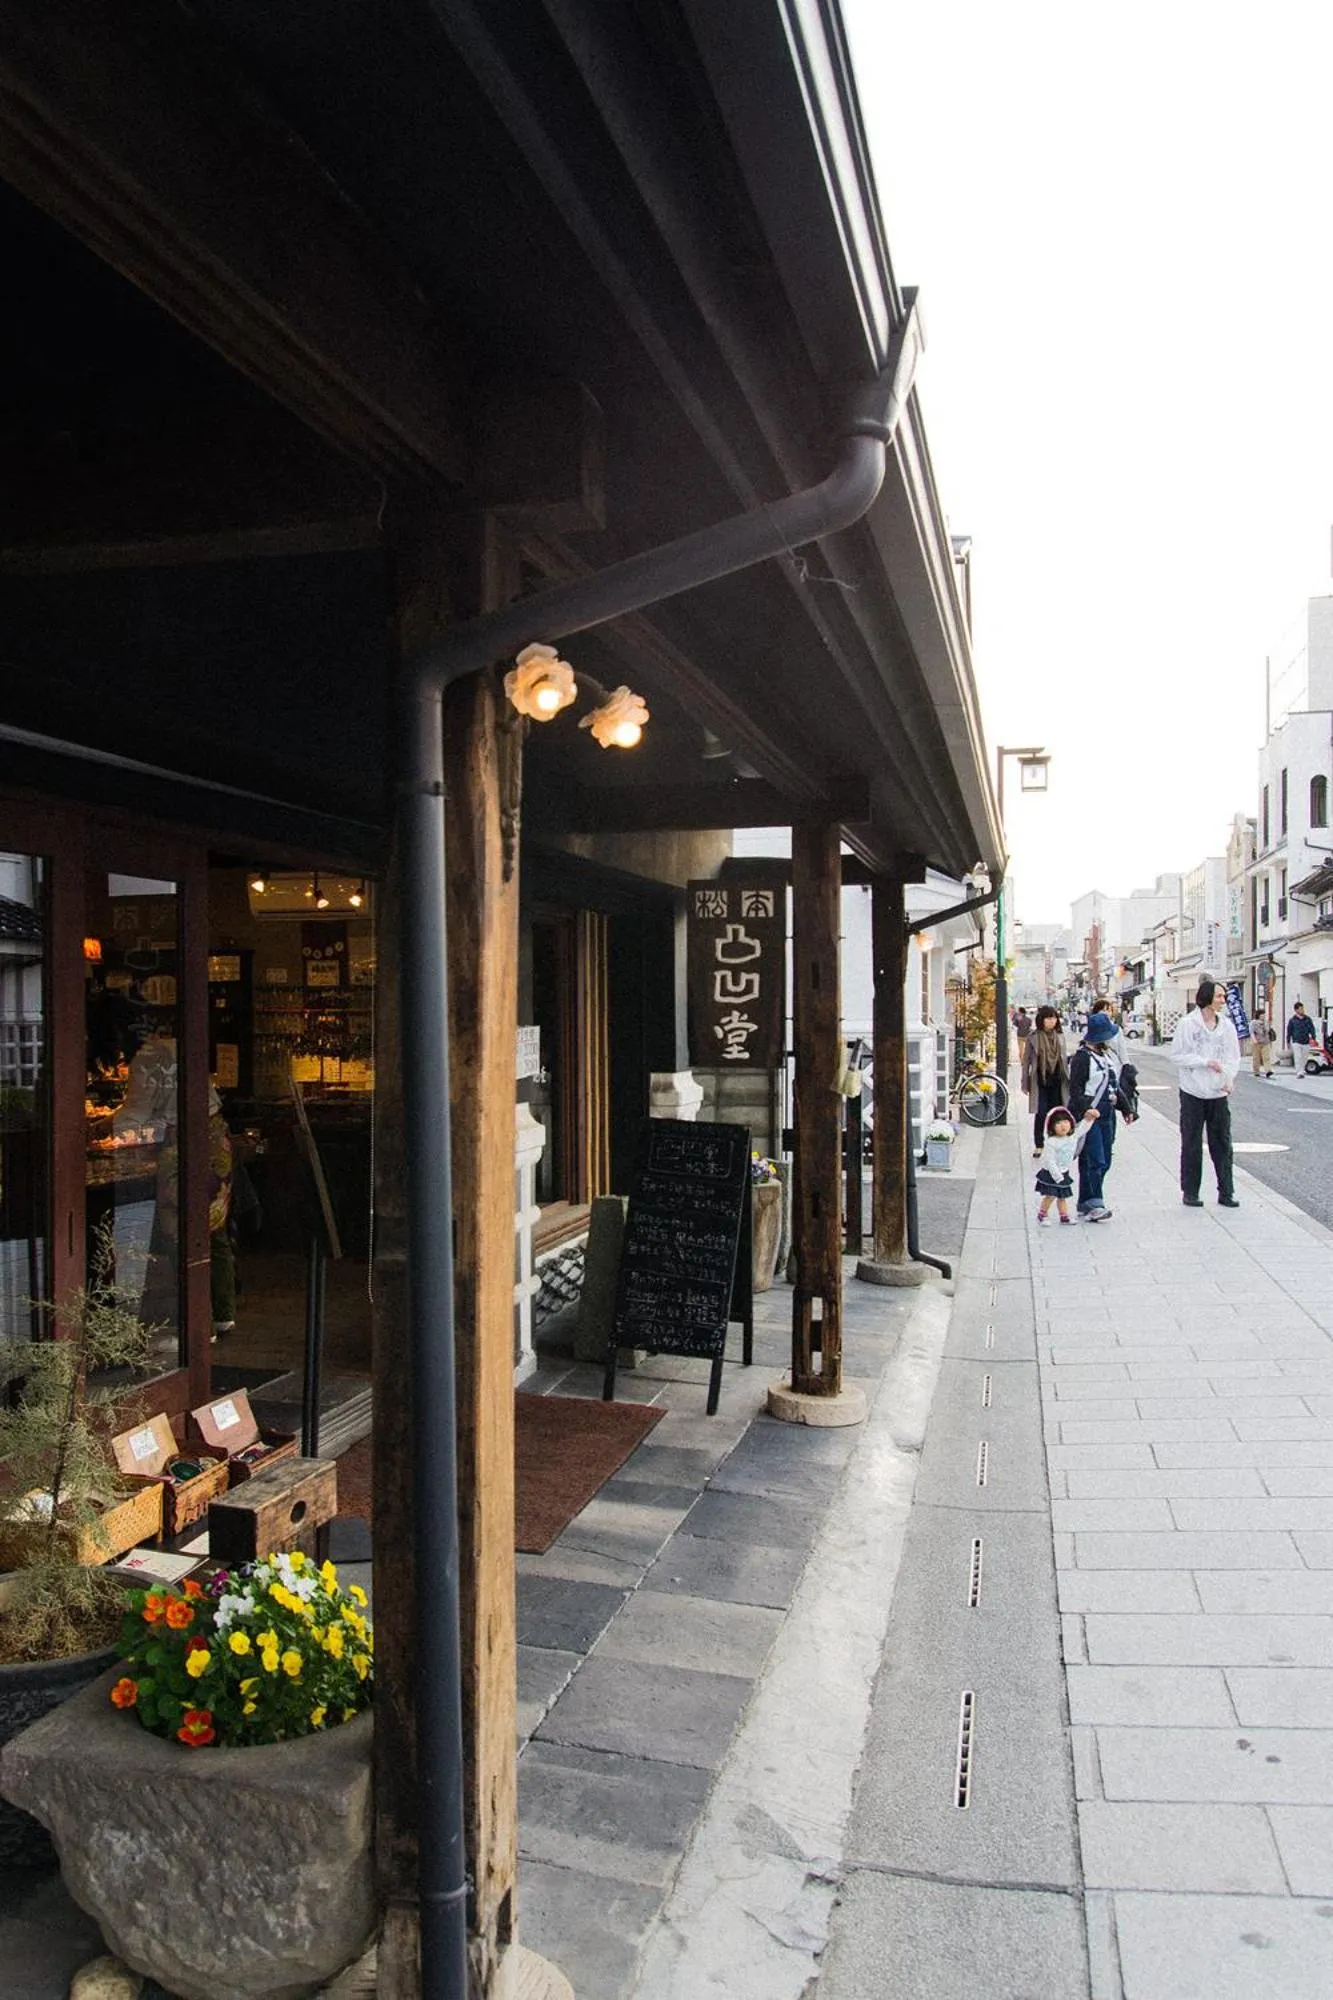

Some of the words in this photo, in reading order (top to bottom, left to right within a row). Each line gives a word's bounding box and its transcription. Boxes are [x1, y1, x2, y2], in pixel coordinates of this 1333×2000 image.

[695, 890, 774, 918] 松本
[714, 923, 762, 1060] 凸凹堂
